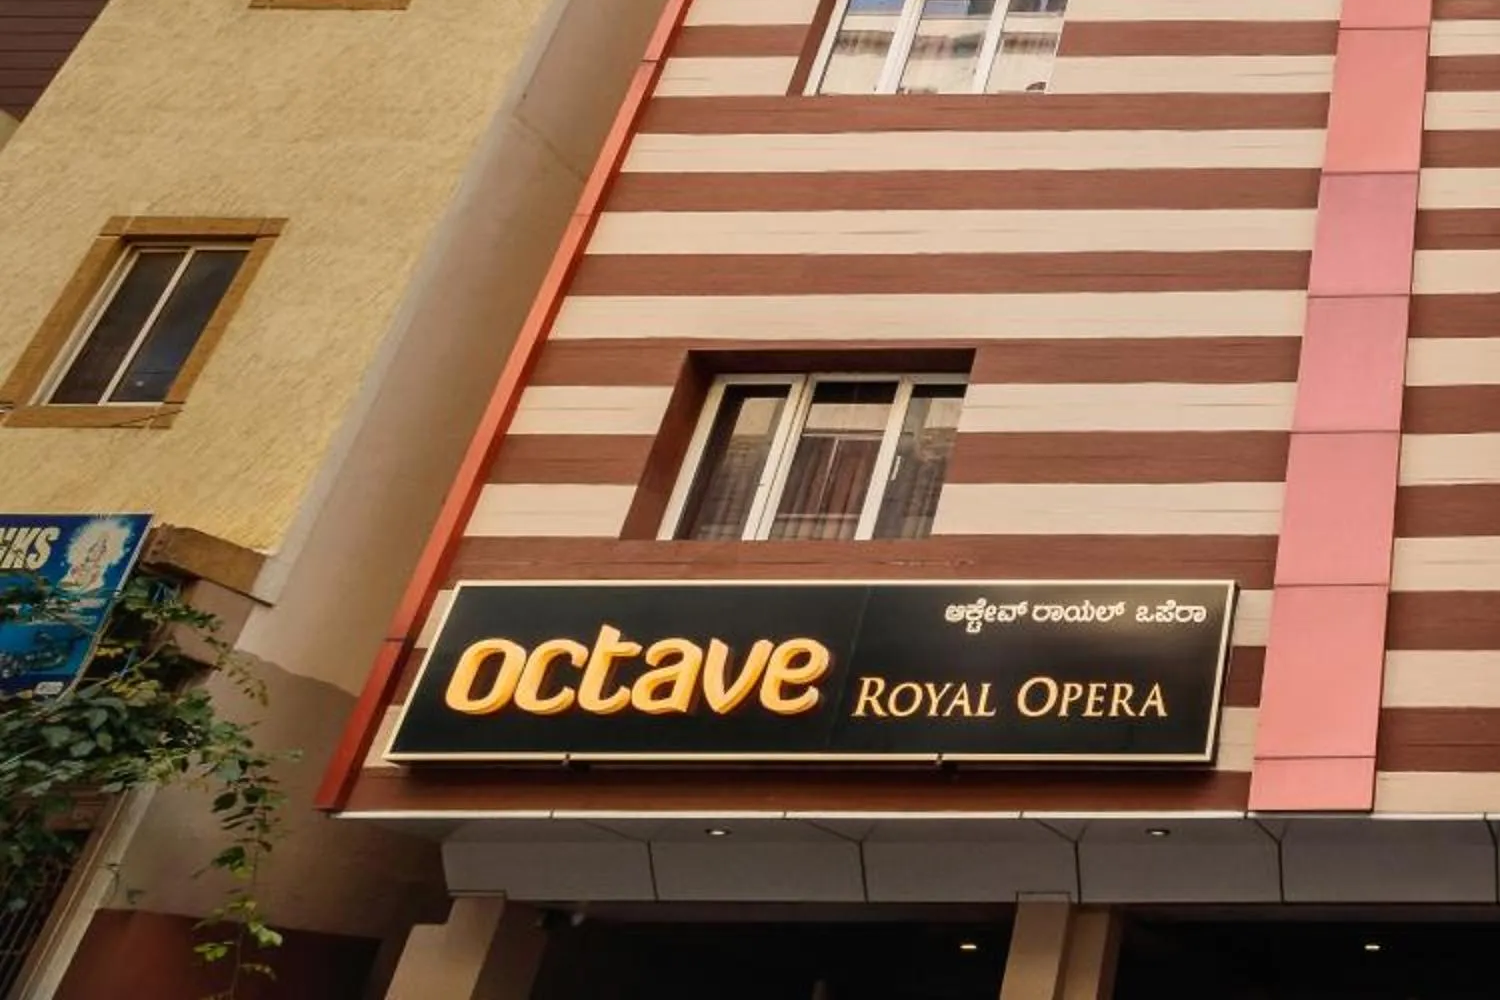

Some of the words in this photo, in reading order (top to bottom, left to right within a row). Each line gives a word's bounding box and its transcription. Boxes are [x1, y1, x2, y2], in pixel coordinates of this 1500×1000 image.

[1031, 600, 1126, 623] ರಾಯಲ್
[1135, 599, 1207, 623] ಒಪೆರಾ
[445, 623, 831, 717] octave
[851, 676, 997, 718] ROYAL
[1016, 676, 1168, 718] OPERA
